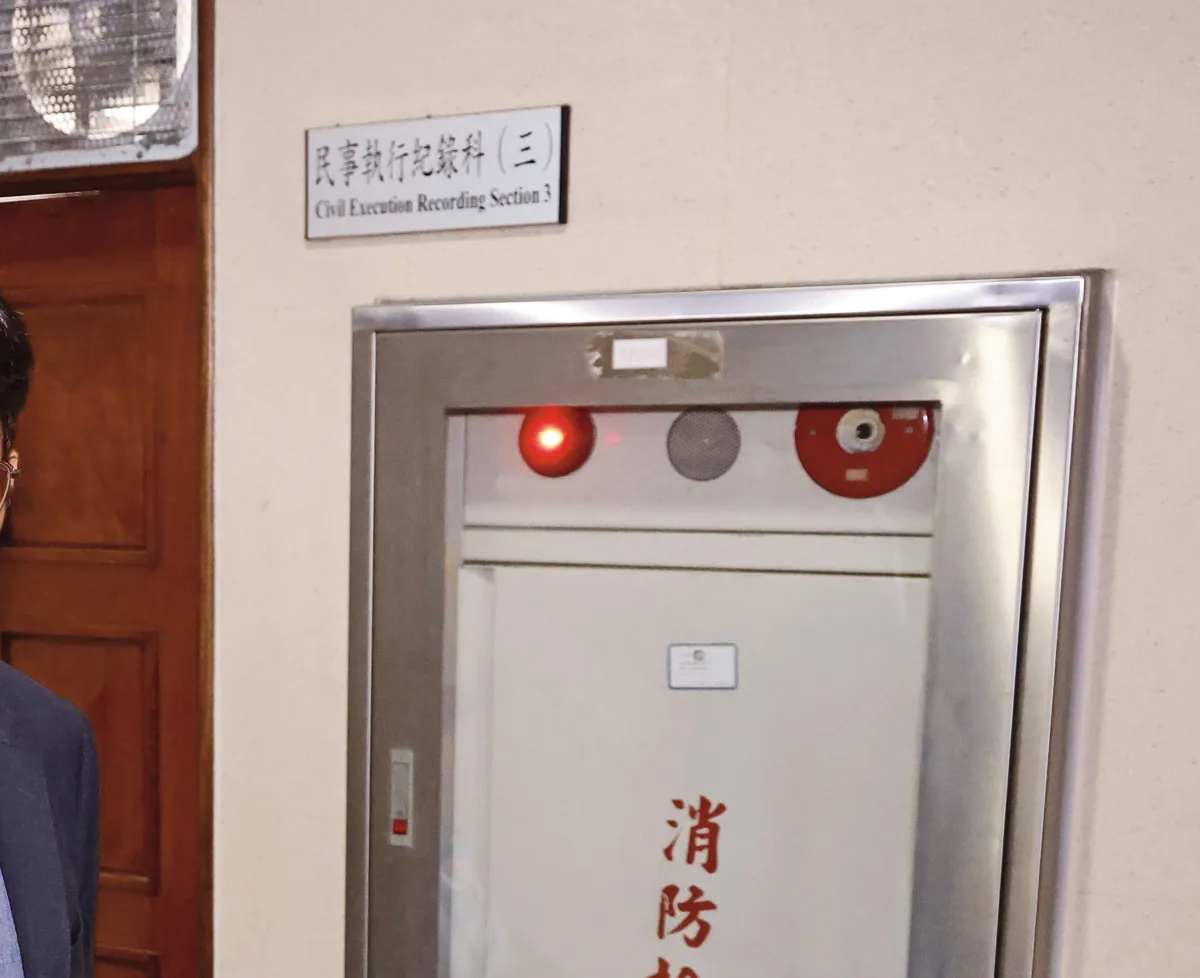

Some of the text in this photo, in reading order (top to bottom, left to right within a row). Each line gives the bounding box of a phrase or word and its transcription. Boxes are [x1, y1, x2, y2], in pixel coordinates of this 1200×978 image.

[315, 183, 552, 219] Civil Execution Recording Section 3
